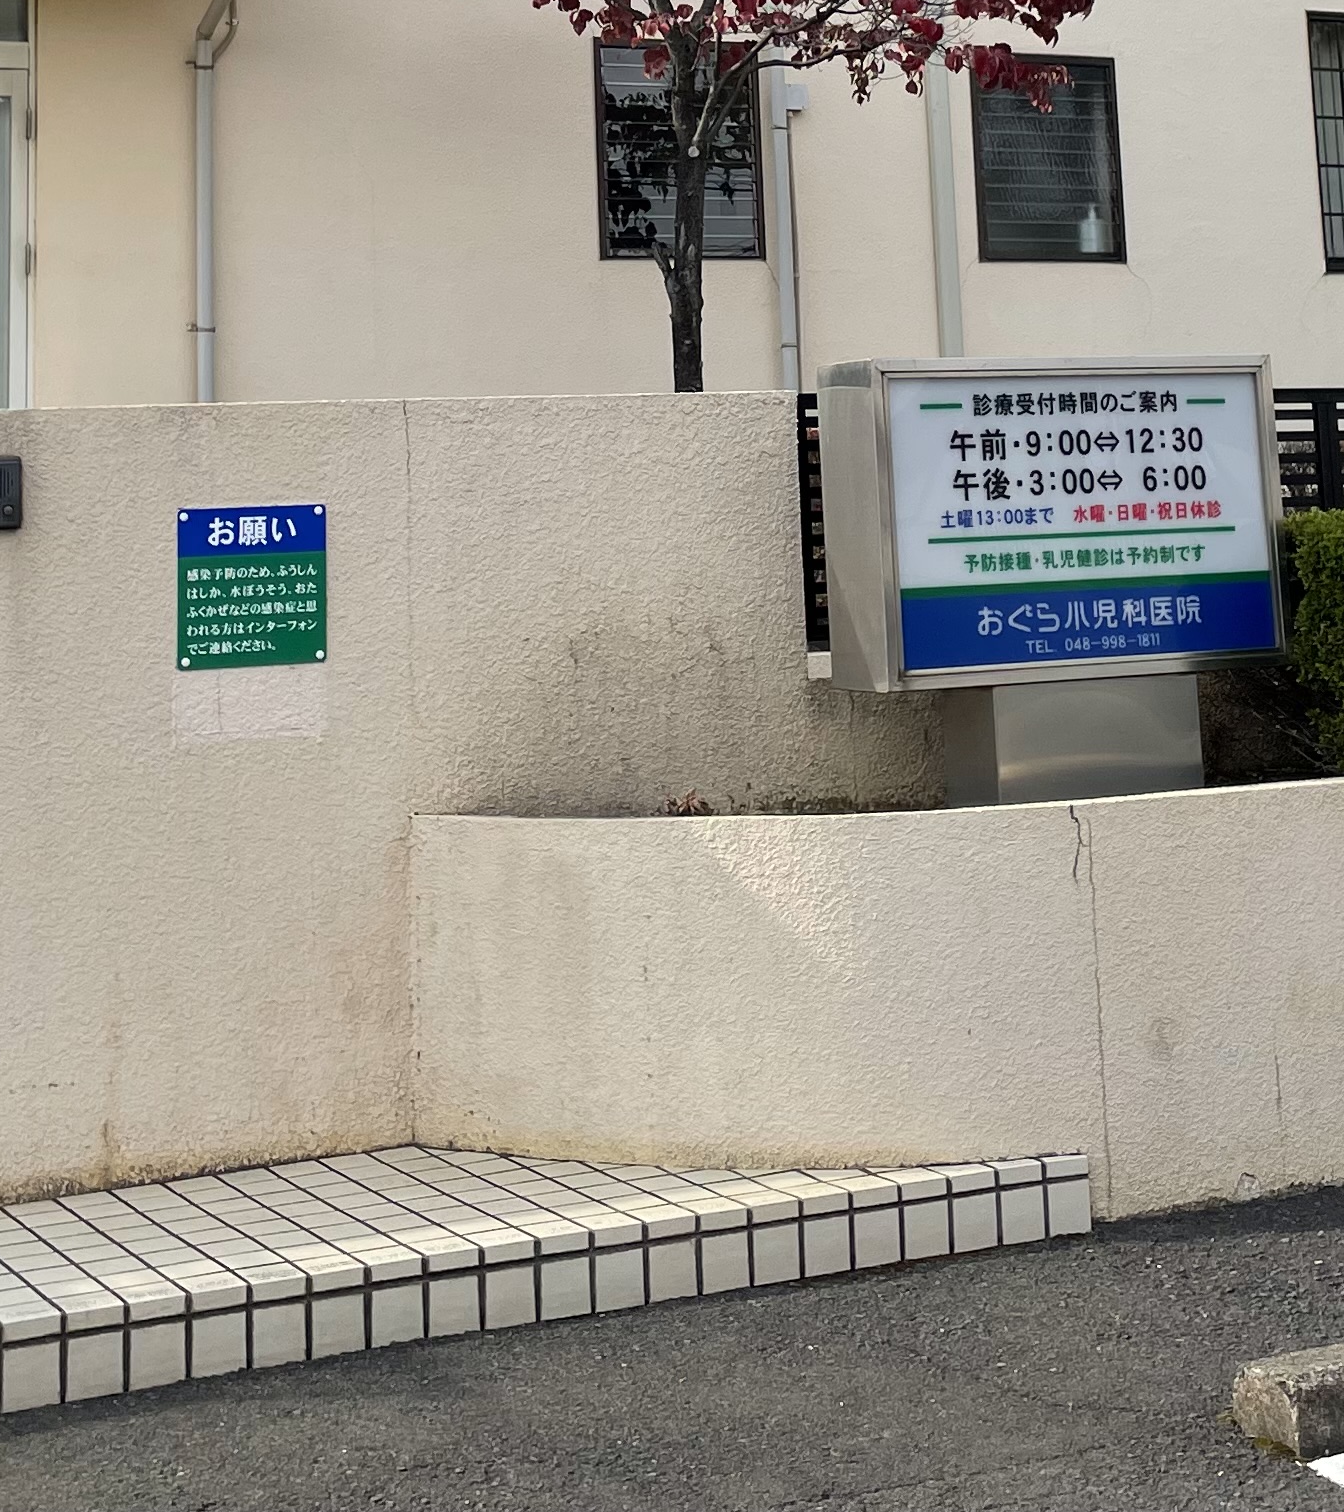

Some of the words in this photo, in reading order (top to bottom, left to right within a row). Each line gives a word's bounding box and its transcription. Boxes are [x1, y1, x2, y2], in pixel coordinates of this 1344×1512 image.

[972, 390, 1178, 416] 診療受付時間のご案内
[940, 507, 1054, 529] 土曜13:00まで
[207, 515, 297, 547] お願い
[964, 544, 1206, 573] 予防接種・乳児健診は予約制です
[977, 594, 1203, 636] おぐら小児科医院
[186, 619, 317, 637] われる方はインターフォン
[186, 639, 276, 656] でご連絡ください。
[1064, 633, 1161, 652] 048-998-1811
